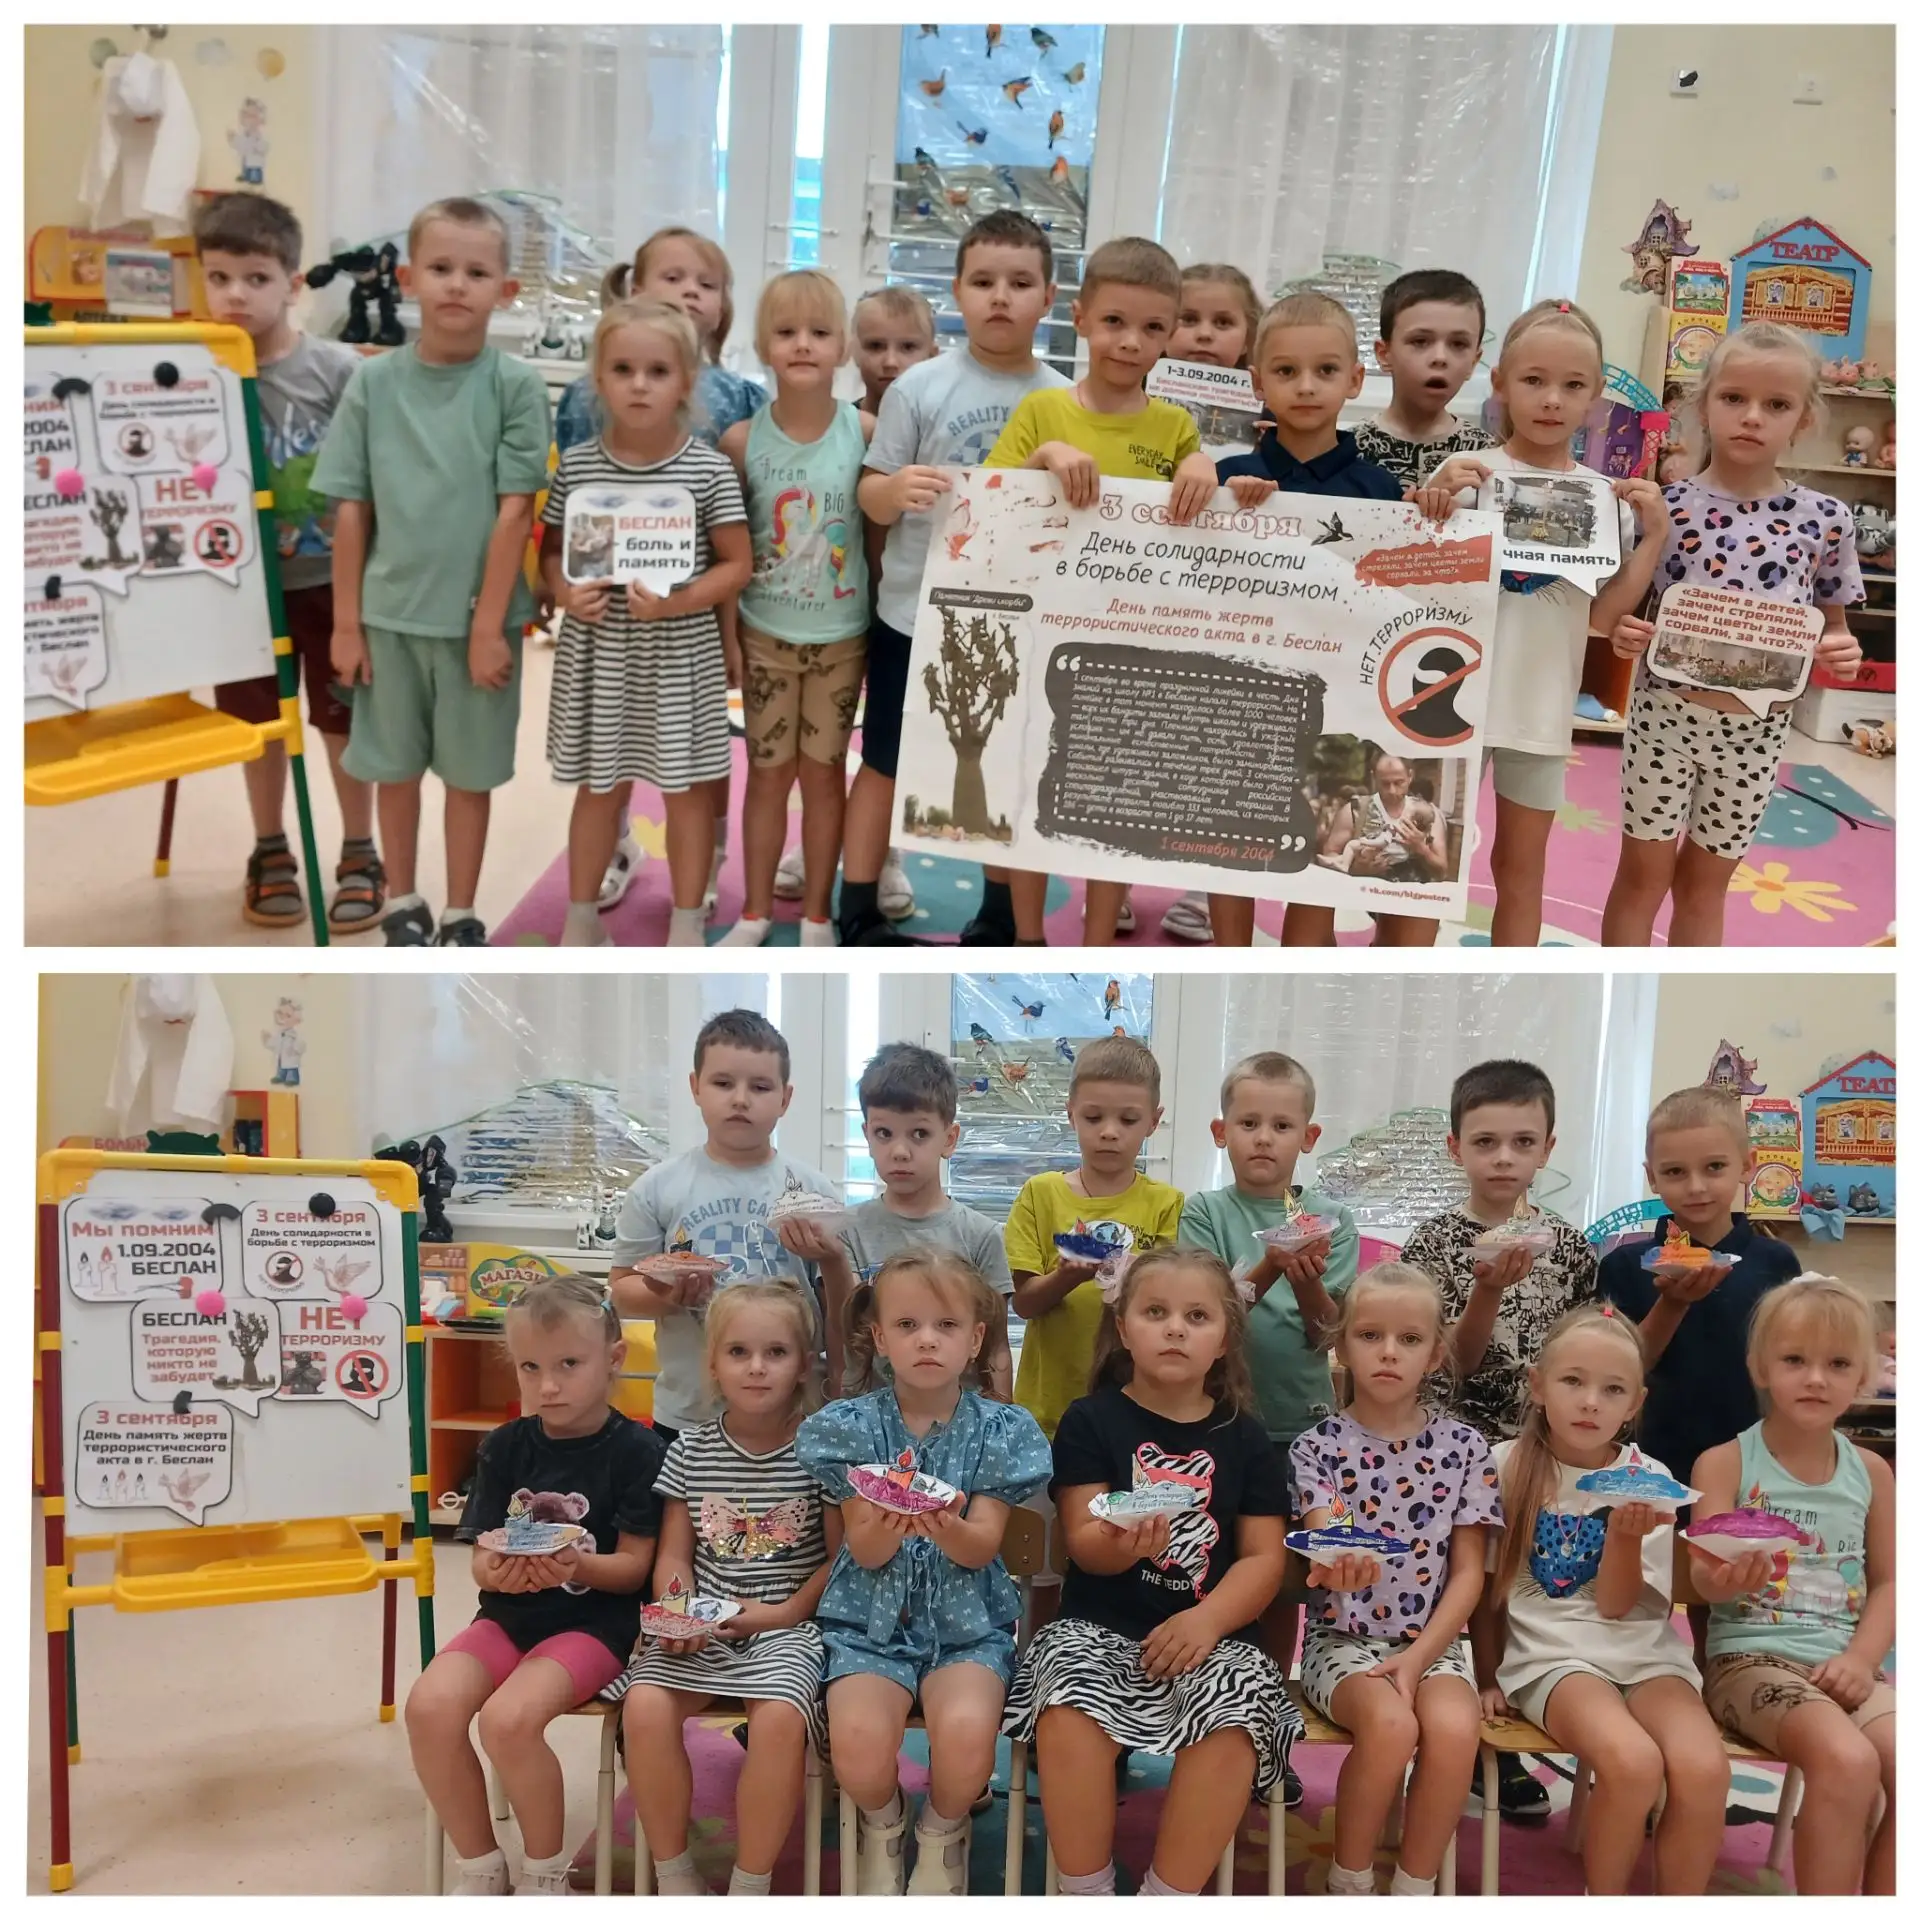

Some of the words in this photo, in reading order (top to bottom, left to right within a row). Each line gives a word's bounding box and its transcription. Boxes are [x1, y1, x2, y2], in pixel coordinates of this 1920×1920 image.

[1770, 241, 1840, 262] ТЕАТР
[1167, 366, 1237, 386] 1-3.09.2004
[947, 406, 1009, 436] REALITY
[762, 458, 807, 481] Dream
[24, 492, 87, 511] ЕСЛАН
[824, 492, 845, 513] BIG
[618, 516, 692, 530] БЕСЛАН
[1100, 493, 1123, 521] 3
[1132, 502, 1301, 539] сетября
[626, 536, 673, 551] боль
[680, 539, 691, 550] и
[1080, 530, 1136, 556] День
[1144, 540, 1306, 572] солидарности
[618, 557, 691, 569] память
[1503, 549, 1545, 563] чная
[1550, 553, 1616, 567] память
[1056, 560, 1067, 575] в
[1076, 556, 1152, 584] борьбе
[1159, 570, 1171, 585] с
[1177, 573, 1339, 602] терроризмом
[1677, 598, 1724, 614] зачем
[1682, 587, 1740, 604] «Зачем
[1744, 599, 1752, 607] в
[1106, 598, 1147, 615] День
[1152, 605, 1212, 622] память
[1218, 611, 1274, 628] жертв
[1040, 612, 1200, 637] террористического
[1204, 628, 1245, 643] акта
[1252, 634, 1260, 645] в
[1266, 635, 1277, 647] г.
[1283, 633, 1342, 653] Беслан
[1662, 606, 1709, 623] зачем
[1713, 616, 1763, 633] цветы
[1766, 626, 1818, 642] земли
[1665, 618, 1732, 640] сорвали,
[1736, 632, 1754, 643] за
[1360, 650, 1377, 686] НЕТ
[1369, 606, 1473, 650] ТЕРРОРИЗМУ
[1170, 839, 1238, 860] сентября
[1837, 1075, 1896, 1095] ТЕАТ
[94, 1137, 148, 1151] БОЛЬН
[256, 1208, 269, 1224] 3
[275, 1209, 366, 1226] сентбря
[681, 1197, 741, 1232] REALITY
[747, 1199, 770, 1218] CA
[72, 1221, 112, 1237] Мы
[121, 1221, 215, 1237] помним
[250, 1228, 280, 1238] День
[283, 1229, 362, 1238] солидарности
[116, 1243, 216, 1258] 1.09.2004
[247, 1238, 288, 1248] борьбе
[301, 1239, 376, 1248] терроризмом
[131, 1260, 216, 1276] БЕСЛАН
[142, 1312, 227, 1327] БЕСЛАН
[281, 1334, 386, 1347] ТЕРРОРИЗМУ
[147, 1347, 216, 1359] которую
[147, 1359, 195, 1369] никто
[198, 1359, 217, 1369] не
[96, 1410, 110, 1425] 3
[116, 1412, 218, 1428] сентября
[83, 1430, 121, 1441] День
[126, 1431, 179, 1440] память
[183, 1431, 228, 1442] жертв
[83, 1443, 227, 1454] террористического
[96, 1456, 130, 1465] акта
[134, 1456, 143, 1465] в
[147, 1456, 158, 1465] г.
[162, 1454, 214, 1465] Беслан
[1141, 1569, 1162, 1586] THE
[1163, 1576, 1197, 1592] TEDDY
